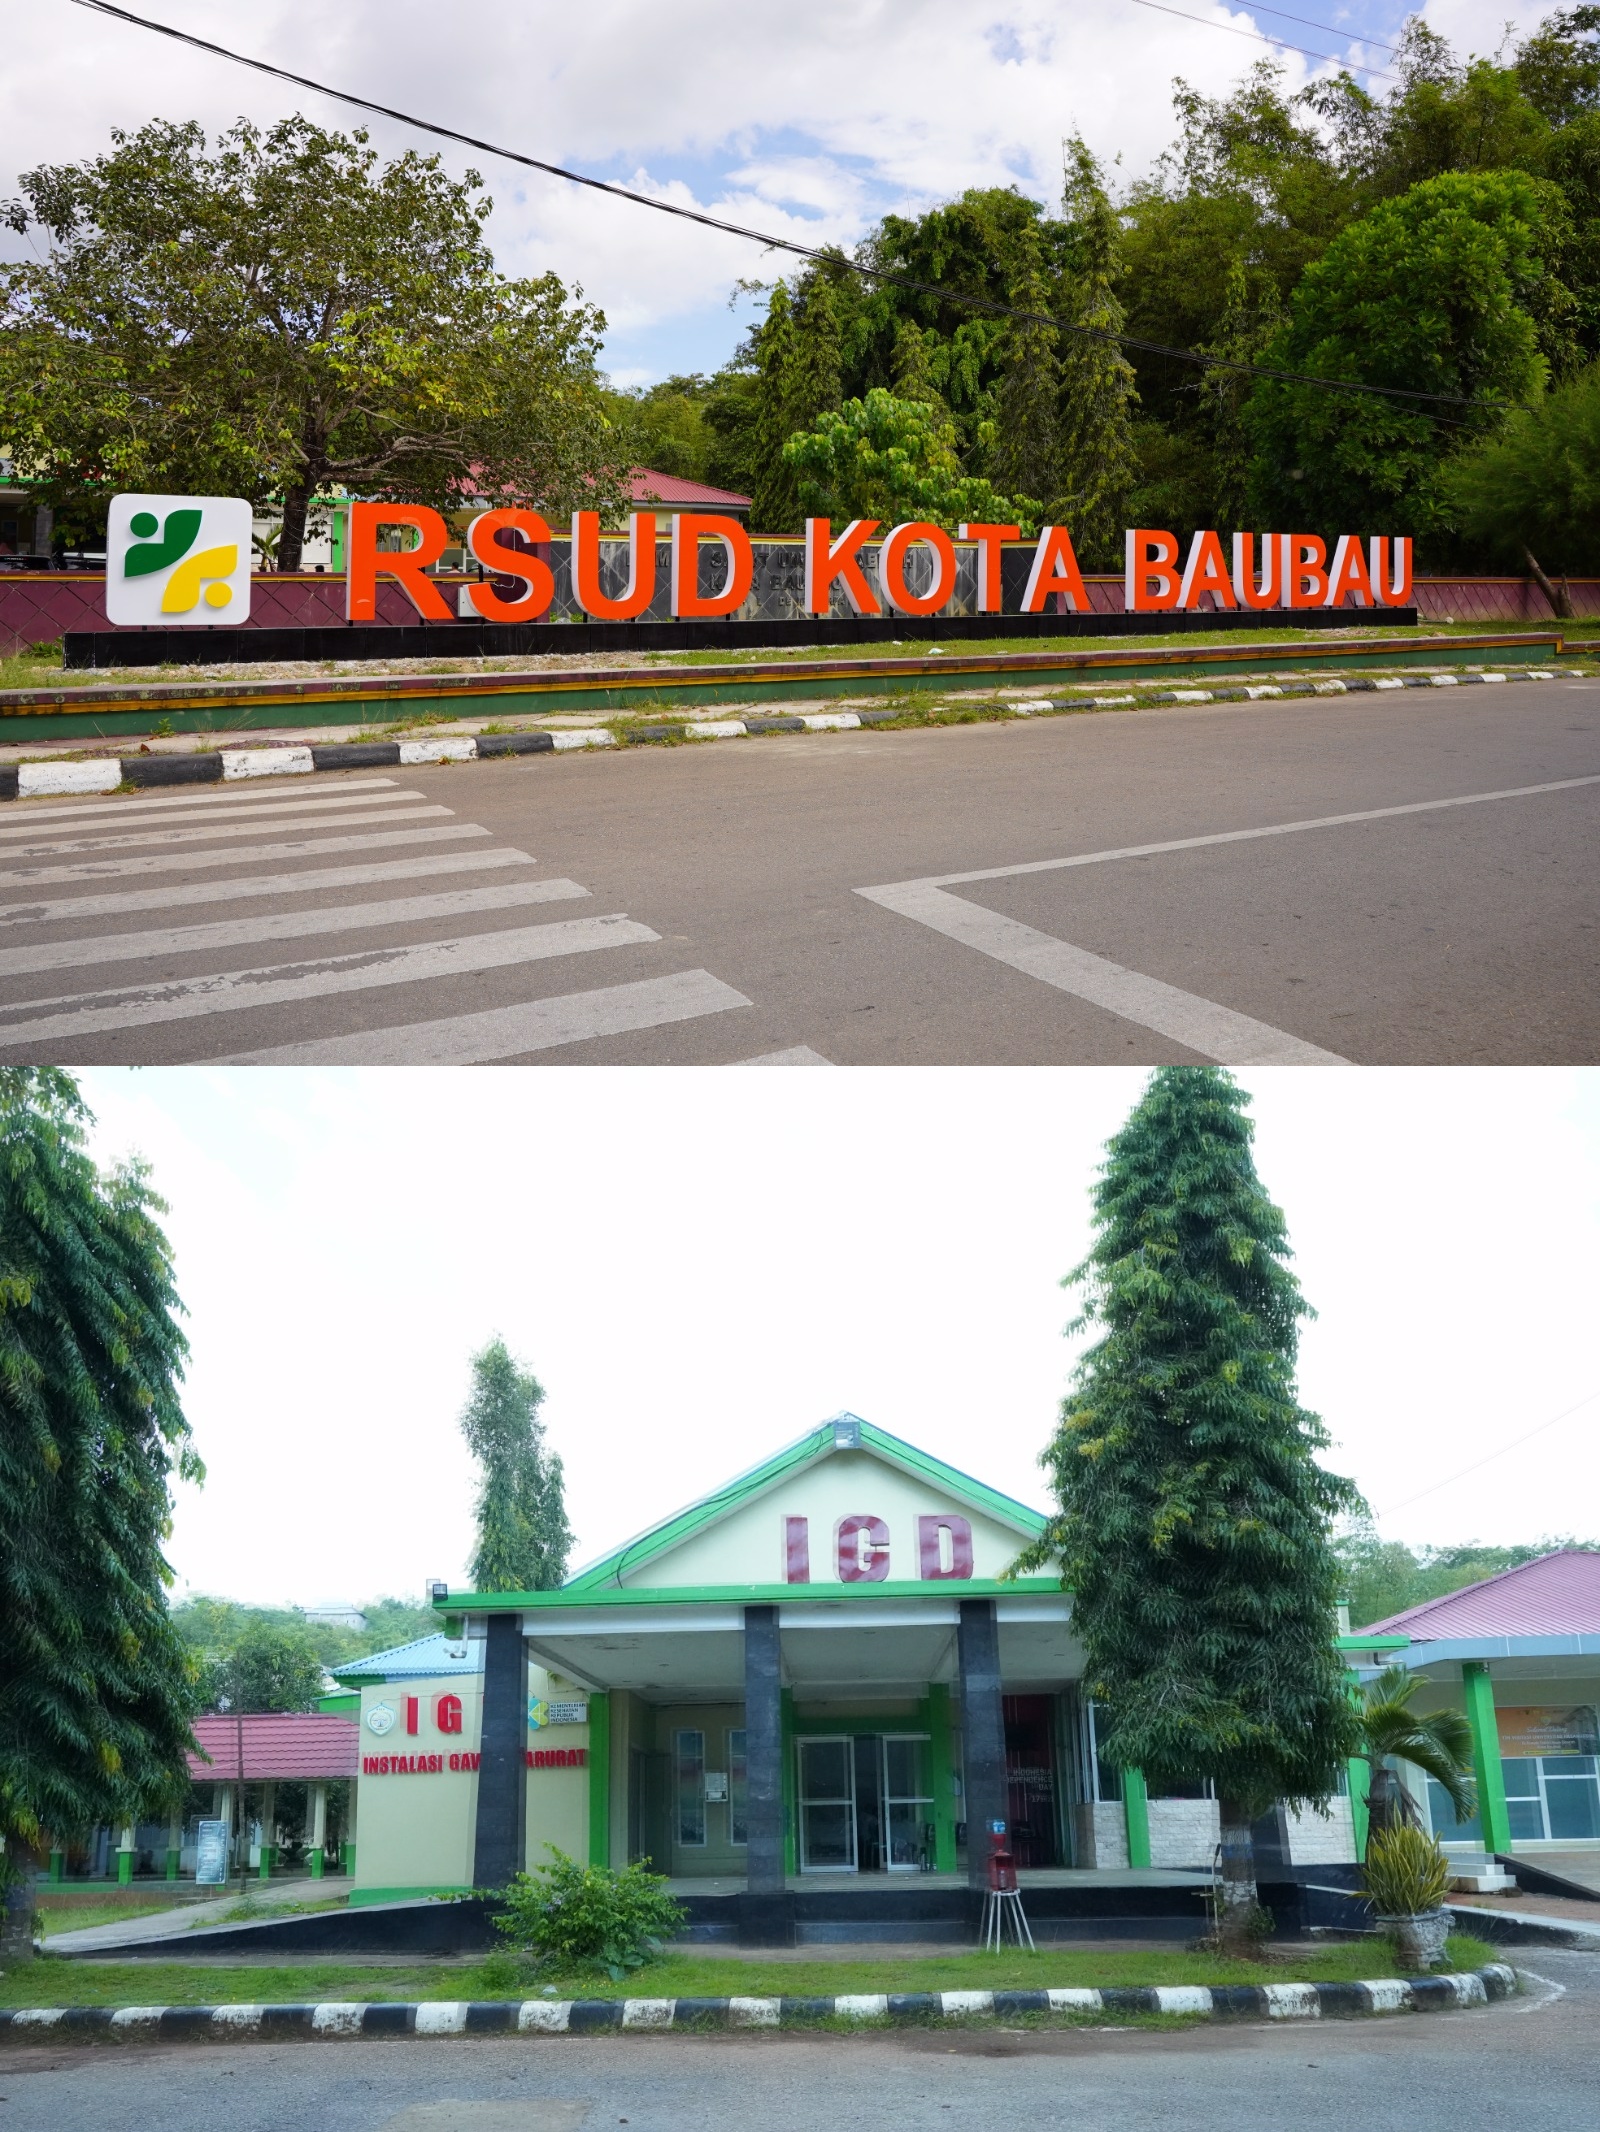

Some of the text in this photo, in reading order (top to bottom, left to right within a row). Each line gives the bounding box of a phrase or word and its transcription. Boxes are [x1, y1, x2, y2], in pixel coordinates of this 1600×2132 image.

[346, 502, 1413, 622] RSUD KOTA BAUBAU
[783, 1514, 974, 1583] IGD
[363, 1754, 443, 1775] INSTALASI
